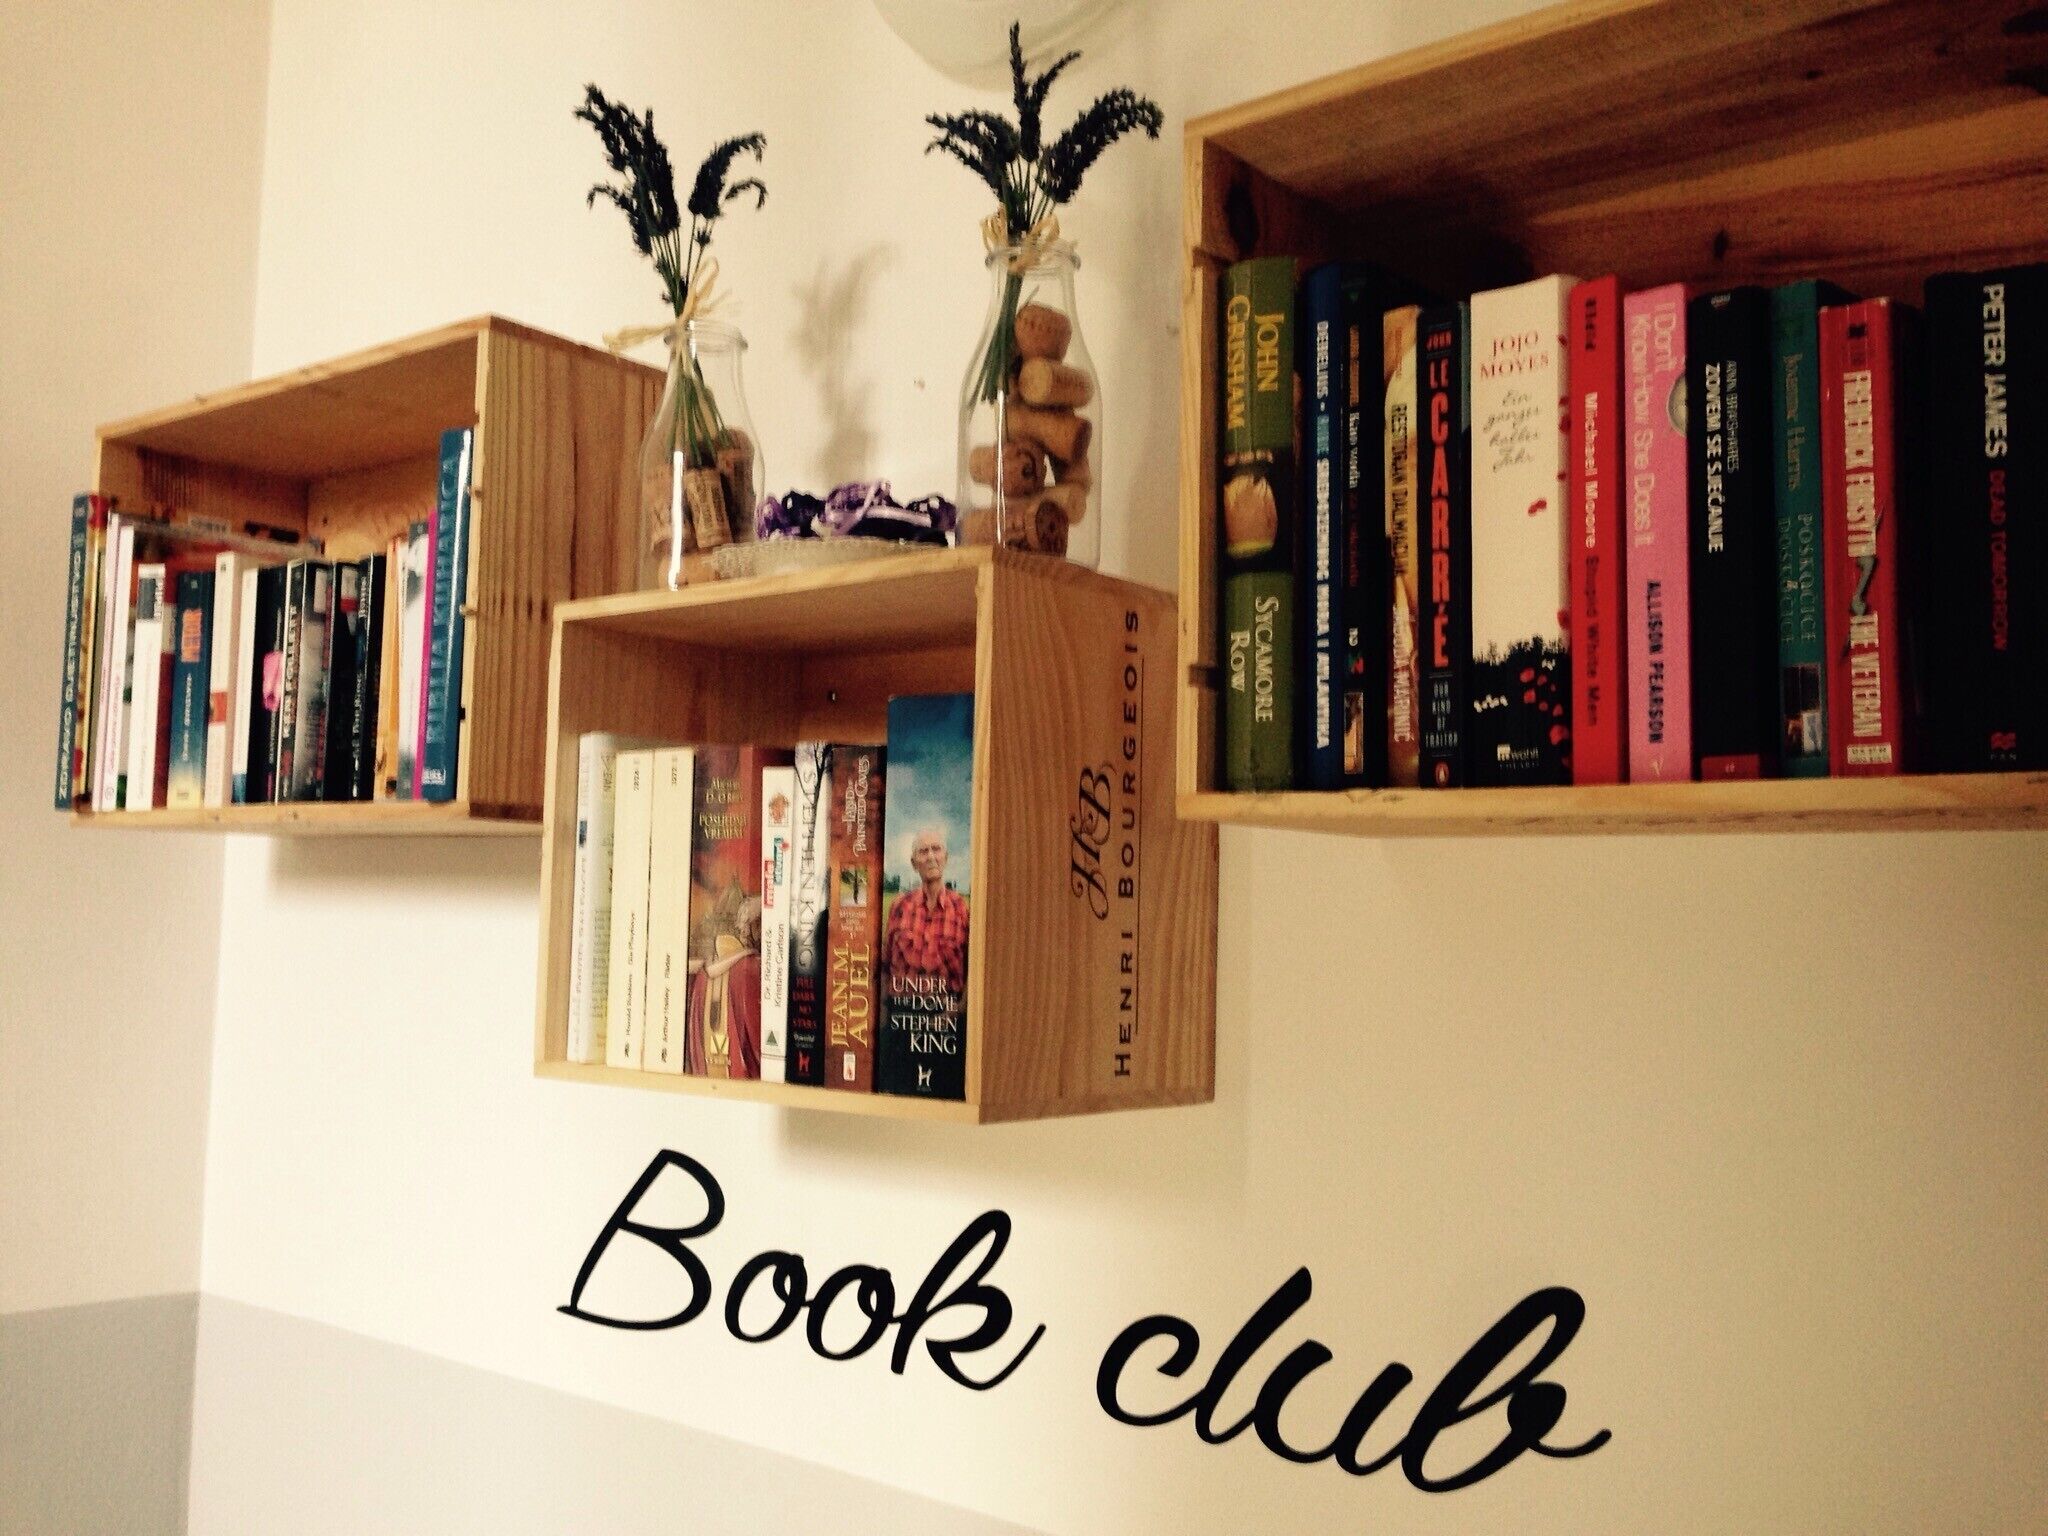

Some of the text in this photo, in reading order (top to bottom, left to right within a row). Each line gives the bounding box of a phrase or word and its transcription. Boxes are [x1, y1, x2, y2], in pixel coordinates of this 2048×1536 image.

[1227, 295, 1251, 430] GRISHAM
[1255, 312, 1285, 392] JOHN
[1430, 359, 1450, 388] LE
[1480, 352, 1549, 379] MOYES
[1492, 331, 1540, 358] JOJO
[1983, 283, 2008, 458] PETER JAMES
[1585, 392, 1599, 549] Michael Moore
[1633, 429, 1653, 471] She
[1707, 434, 1721, 458] SE
[1634, 473, 1655, 530] Does
[1989, 468, 2008, 652] DEAD TOMORROW
[1255, 596, 1280, 724] SYCAMORE
[1648, 661, 1665, 744] PEARSON
[1114, 609, 1140, 1078] HENRI BOURGEOIS
[832, 972, 850, 1048] JEAN
[849, 943, 871, 1048] AUEL
[891, 975, 948, 994] UNDER
[911, 995, 959, 1012] DOME
[890, 1013, 958, 1033] STEPHEN
[909, 1033, 958, 1055] KING
[556, 1148, 1613, 1493] Book club
